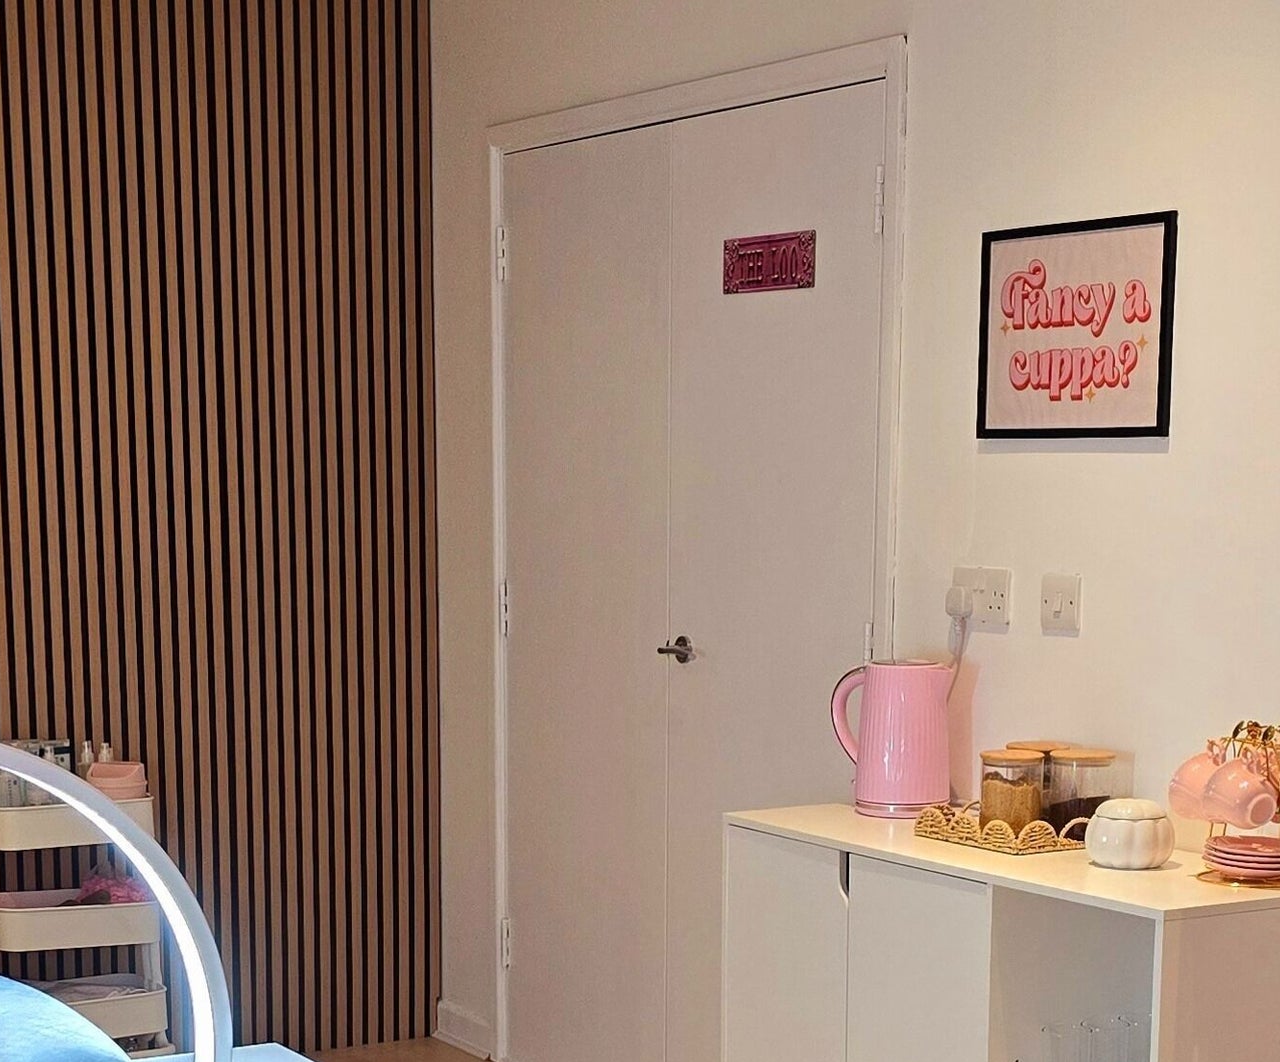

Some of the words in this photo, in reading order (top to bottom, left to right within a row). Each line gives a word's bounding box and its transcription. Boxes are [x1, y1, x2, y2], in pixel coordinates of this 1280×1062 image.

[737, 249, 764, 284] THE
[769, 244, 801, 281] LOO
[1001, 259, 1116, 337] Fancy
[1122, 279, 1152, 324] a
[1009, 340, 1138, 402] cuppa?
